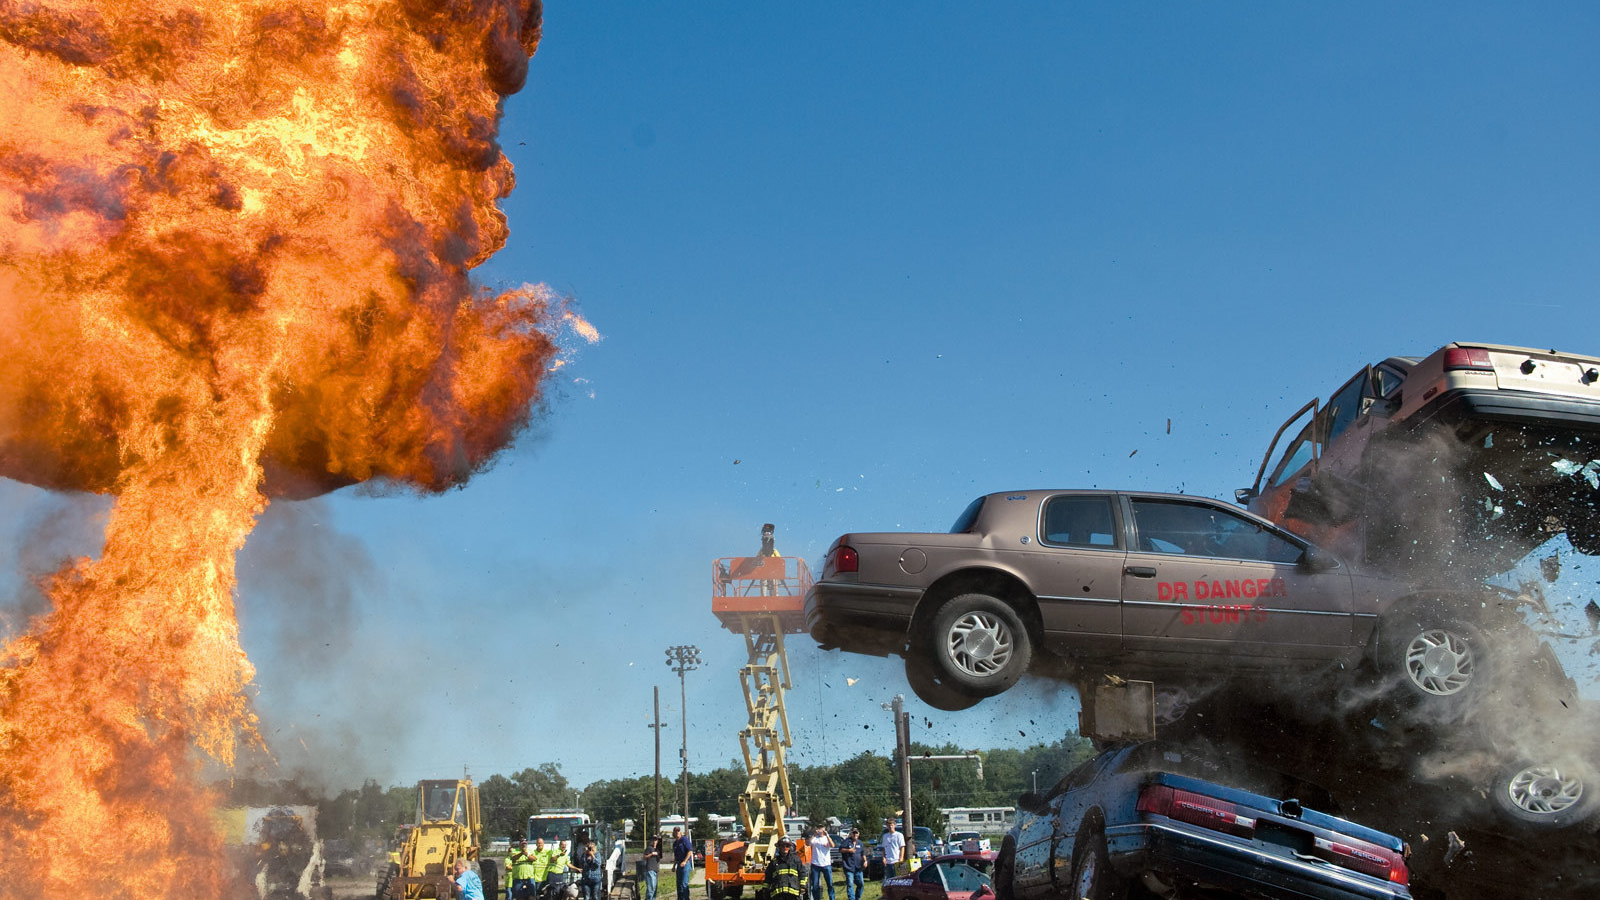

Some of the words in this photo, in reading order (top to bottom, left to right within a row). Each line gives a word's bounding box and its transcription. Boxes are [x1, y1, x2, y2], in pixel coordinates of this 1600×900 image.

[1157, 581, 1189, 601] DR
[1194, 578, 1287, 600] DANGER
[1181, 603, 1268, 625] STUNTS
[1351, 849, 1387, 864] MERCURY
